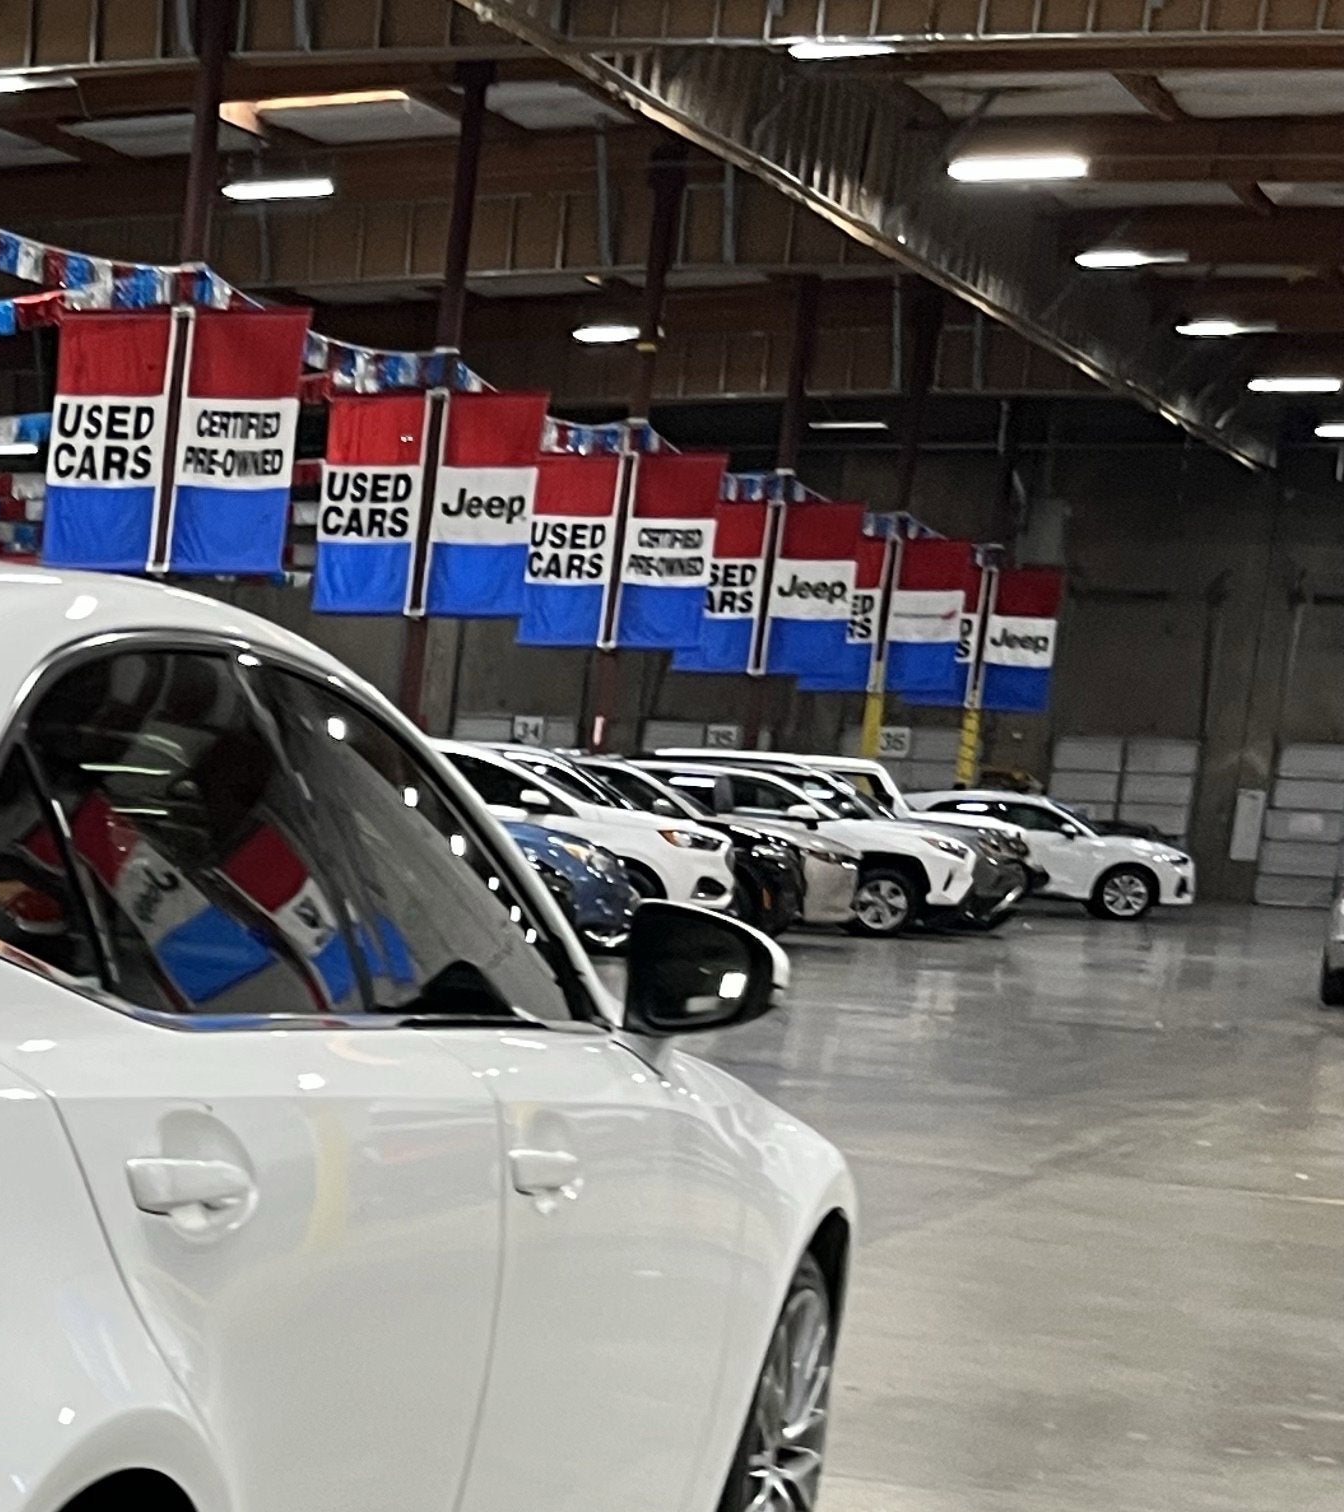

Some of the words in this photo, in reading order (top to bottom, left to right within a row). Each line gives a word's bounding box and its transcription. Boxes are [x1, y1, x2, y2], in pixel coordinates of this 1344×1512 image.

[57, 403, 155, 440] USED
[53, 443, 152, 480] CARS
[327, 472, 412, 503] USED
[322, 506, 409, 537] CARS
[442, 488, 526, 525] Jeep
[531, 522, 606, 549] USED
[528, 552, 603, 579] CARS
[708, 564, 757, 587] SED
[777, 575, 847, 604] Jeep
[990, 628, 1049, 653] Jeep
